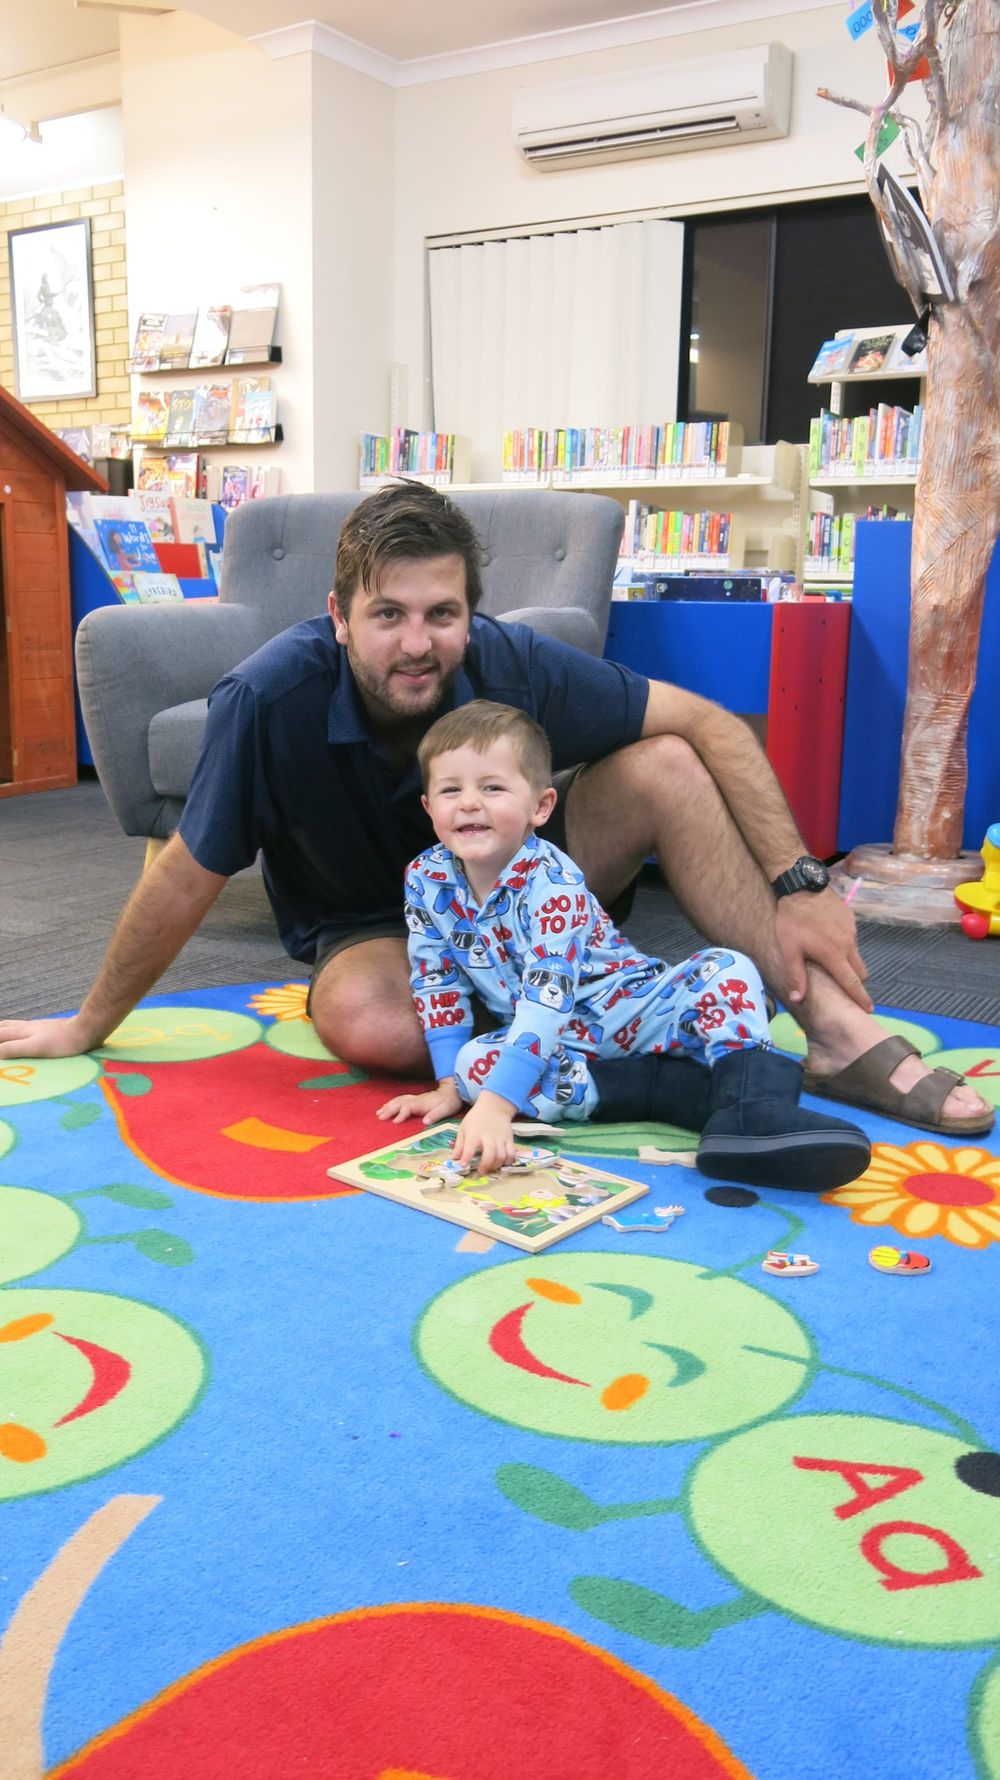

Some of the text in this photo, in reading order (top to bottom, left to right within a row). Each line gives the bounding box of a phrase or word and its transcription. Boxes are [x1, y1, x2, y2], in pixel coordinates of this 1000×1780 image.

[540, 915, 566, 935] TO
[430, 991, 461, 1010] HIP
[428, 1008, 465, 1029] HOP
